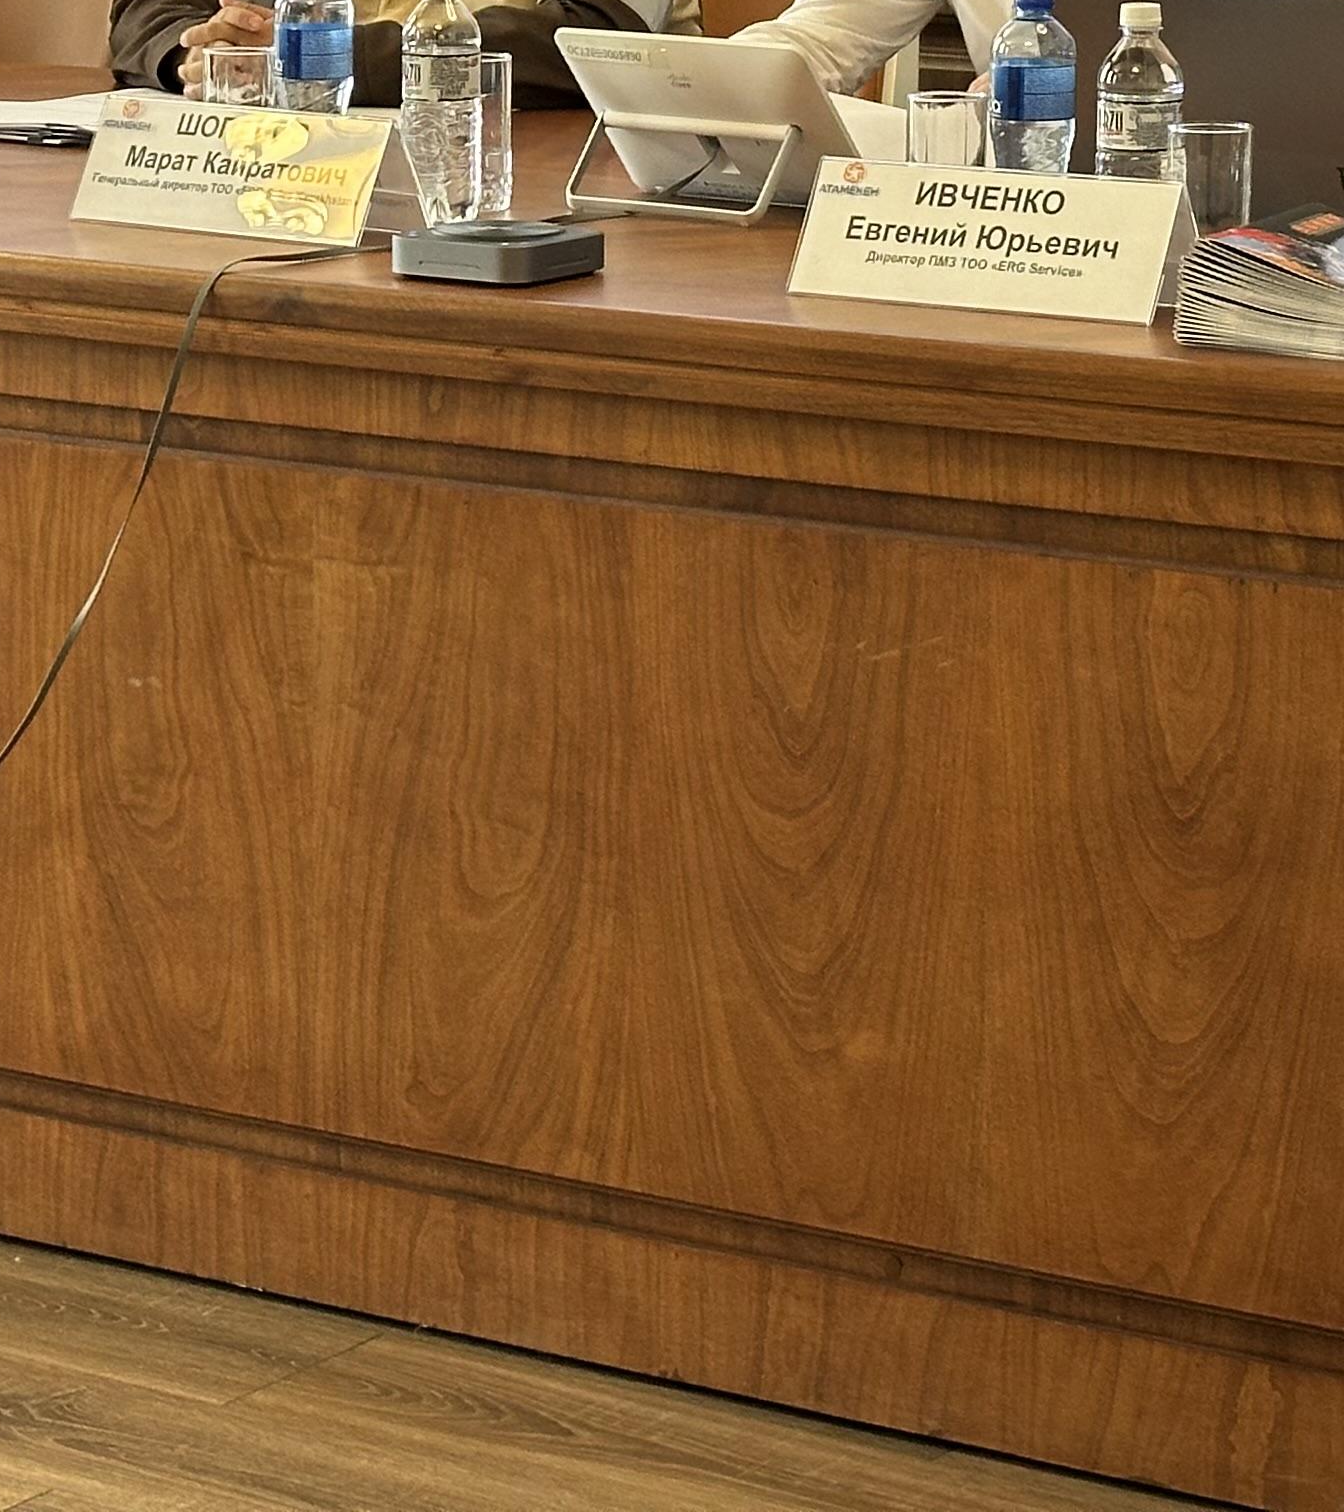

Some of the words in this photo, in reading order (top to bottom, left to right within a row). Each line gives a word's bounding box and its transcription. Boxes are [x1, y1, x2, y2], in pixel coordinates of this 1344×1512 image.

[125, 145, 198, 175] Марат
[914, 181, 1066, 215] ИВЧЕНКО
[845, 215, 968, 248] Евгений
[975, 224, 1120, 260] Юрьевич
[865, 250, 927, 268] Директор
[961, 256, 988, 270] ТОО
[991, 260, 1026, 273] «ERG
